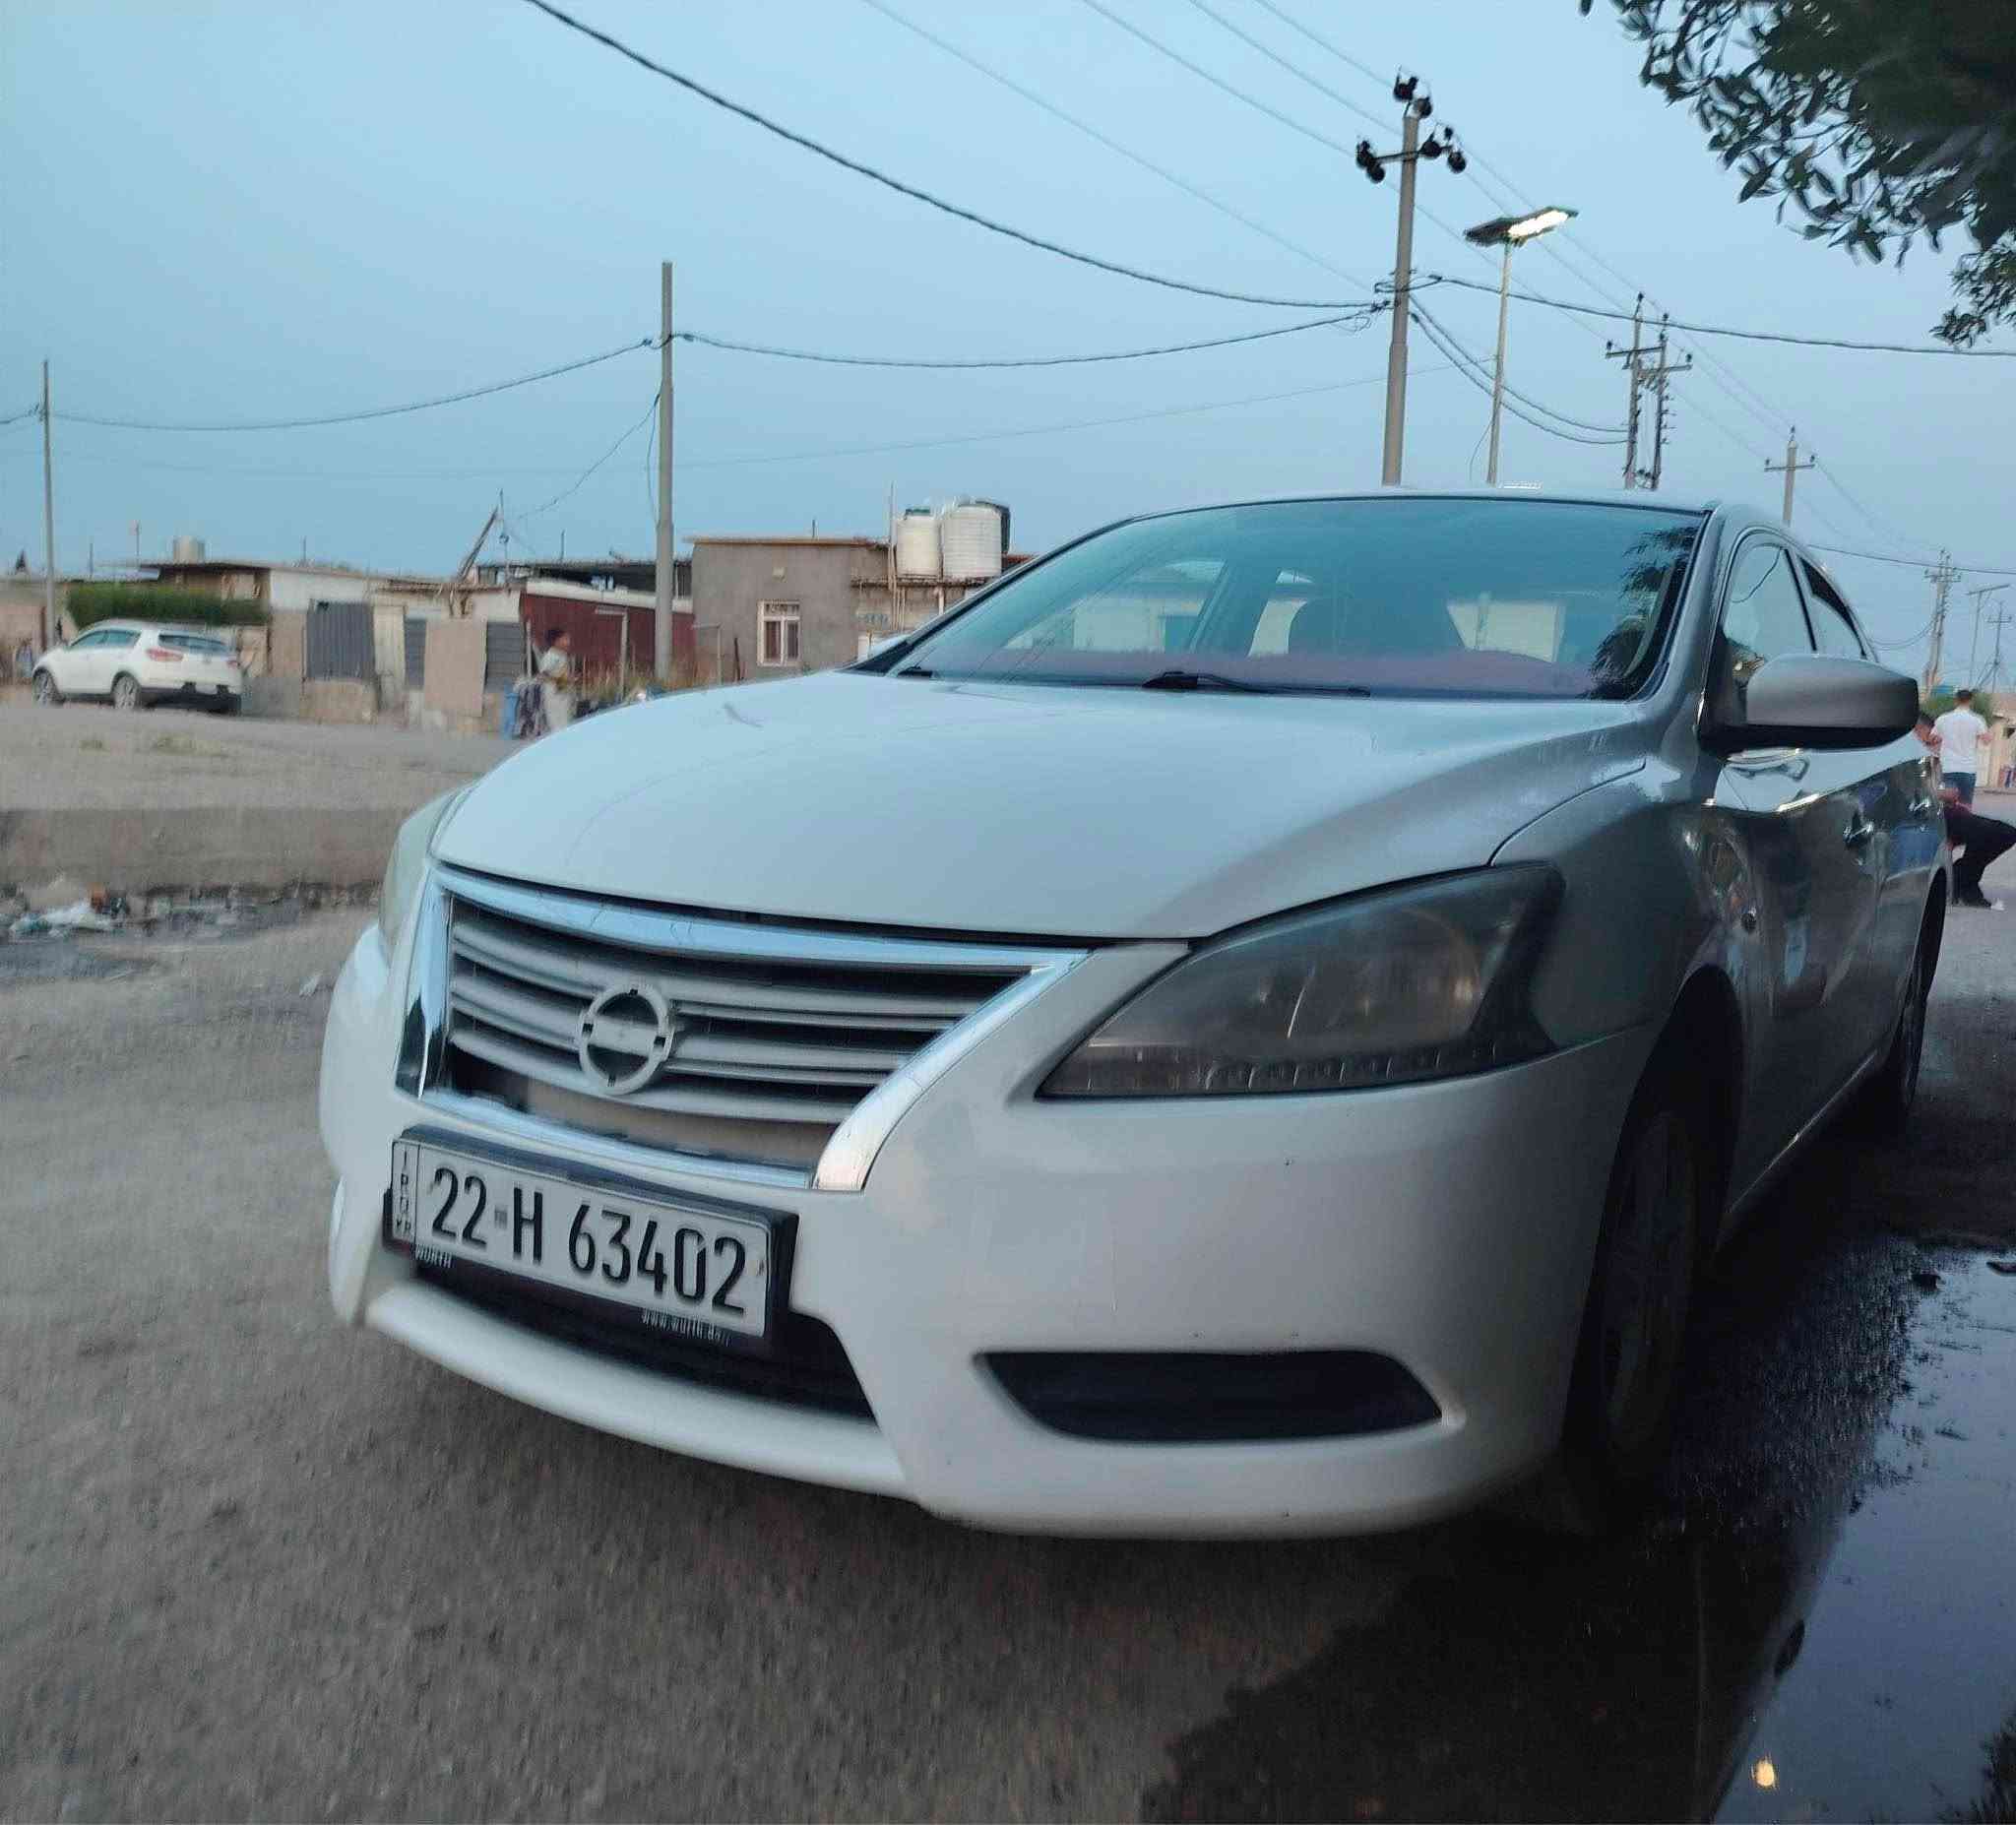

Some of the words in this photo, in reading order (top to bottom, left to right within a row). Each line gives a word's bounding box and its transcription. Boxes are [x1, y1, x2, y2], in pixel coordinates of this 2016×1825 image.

[431, 1167, 488, 1249] 22
[513, 1186, 543, 1264] H
[569, 1203, 745, 1314] 63402
